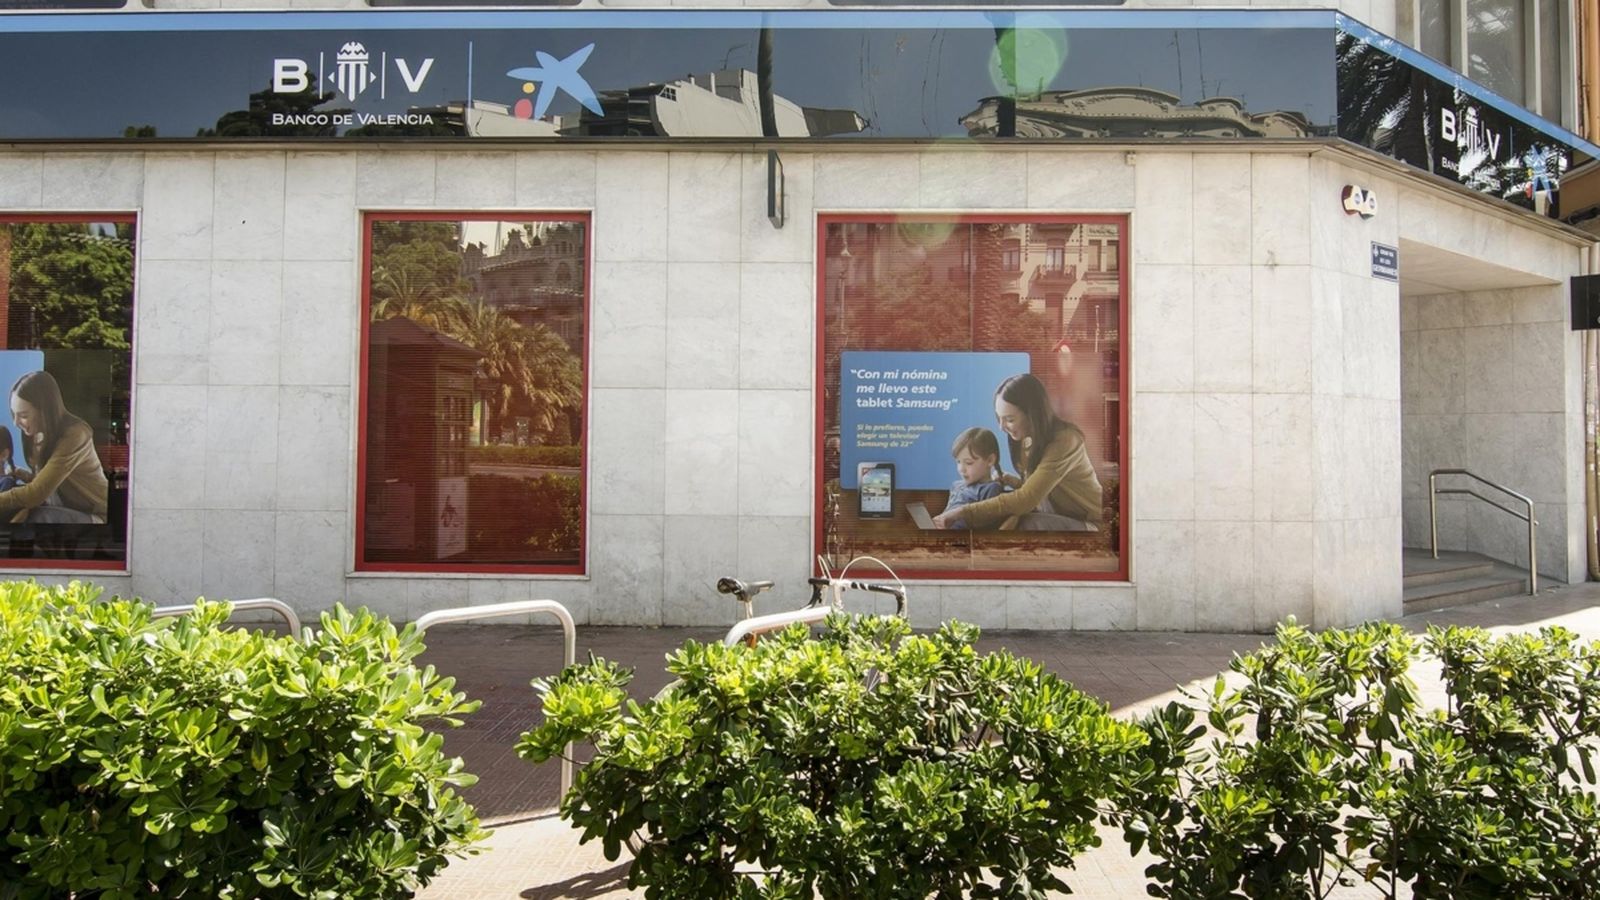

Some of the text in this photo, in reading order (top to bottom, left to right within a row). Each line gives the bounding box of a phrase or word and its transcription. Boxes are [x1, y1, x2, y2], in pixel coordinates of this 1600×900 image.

[274, 59, 434, 93] B V
[272, 113, 434, 125] BANCO DE VALENCIA
[1441, 107, 1500, 160] B V
[850, 369, 947, 379] “Con mi nómina
[856, 383, 937, 393] me llevo este
[856, 397, 893, 408] tablet
